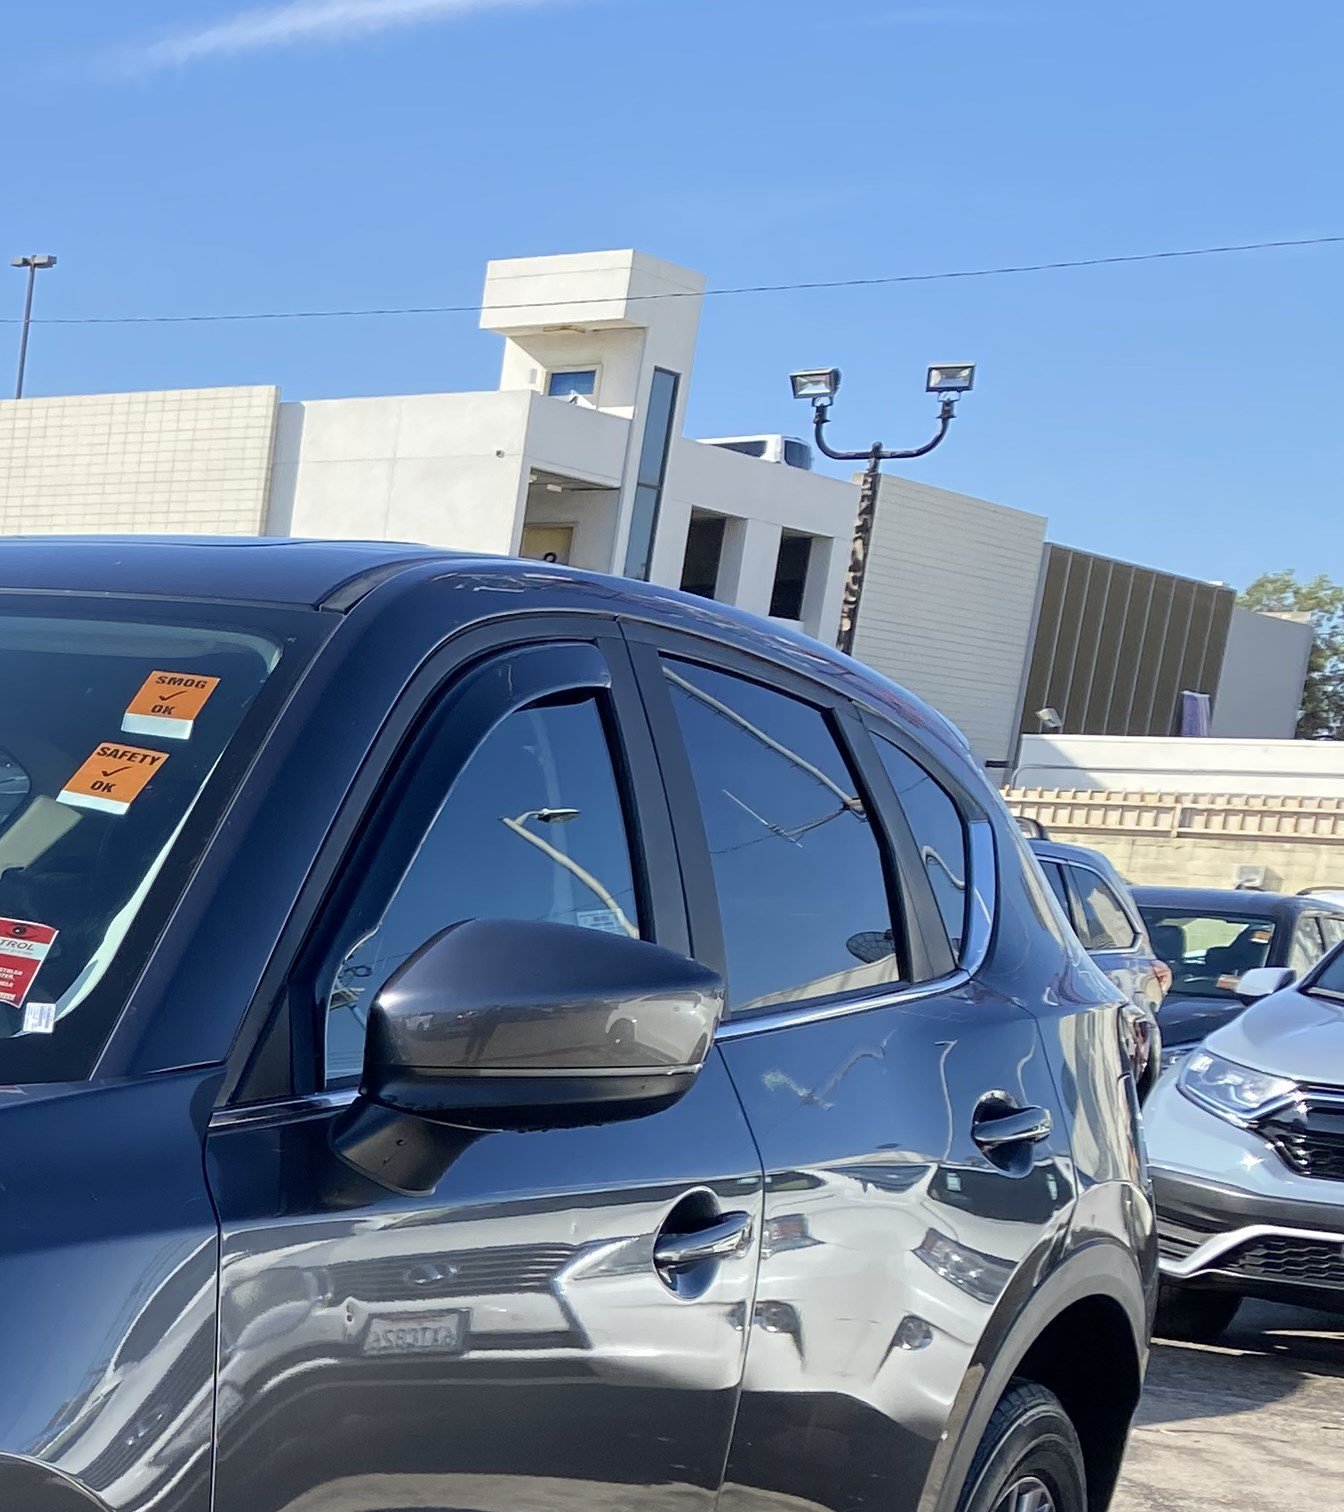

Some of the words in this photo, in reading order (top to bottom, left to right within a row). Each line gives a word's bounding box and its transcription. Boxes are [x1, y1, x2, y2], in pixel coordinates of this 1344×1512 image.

[155, 675, 208, 689] SMOG
[151, 704, 175, 715] OK
[96, 746, 162, 766] SAFETY
[90, 780, 116, 793] OK
